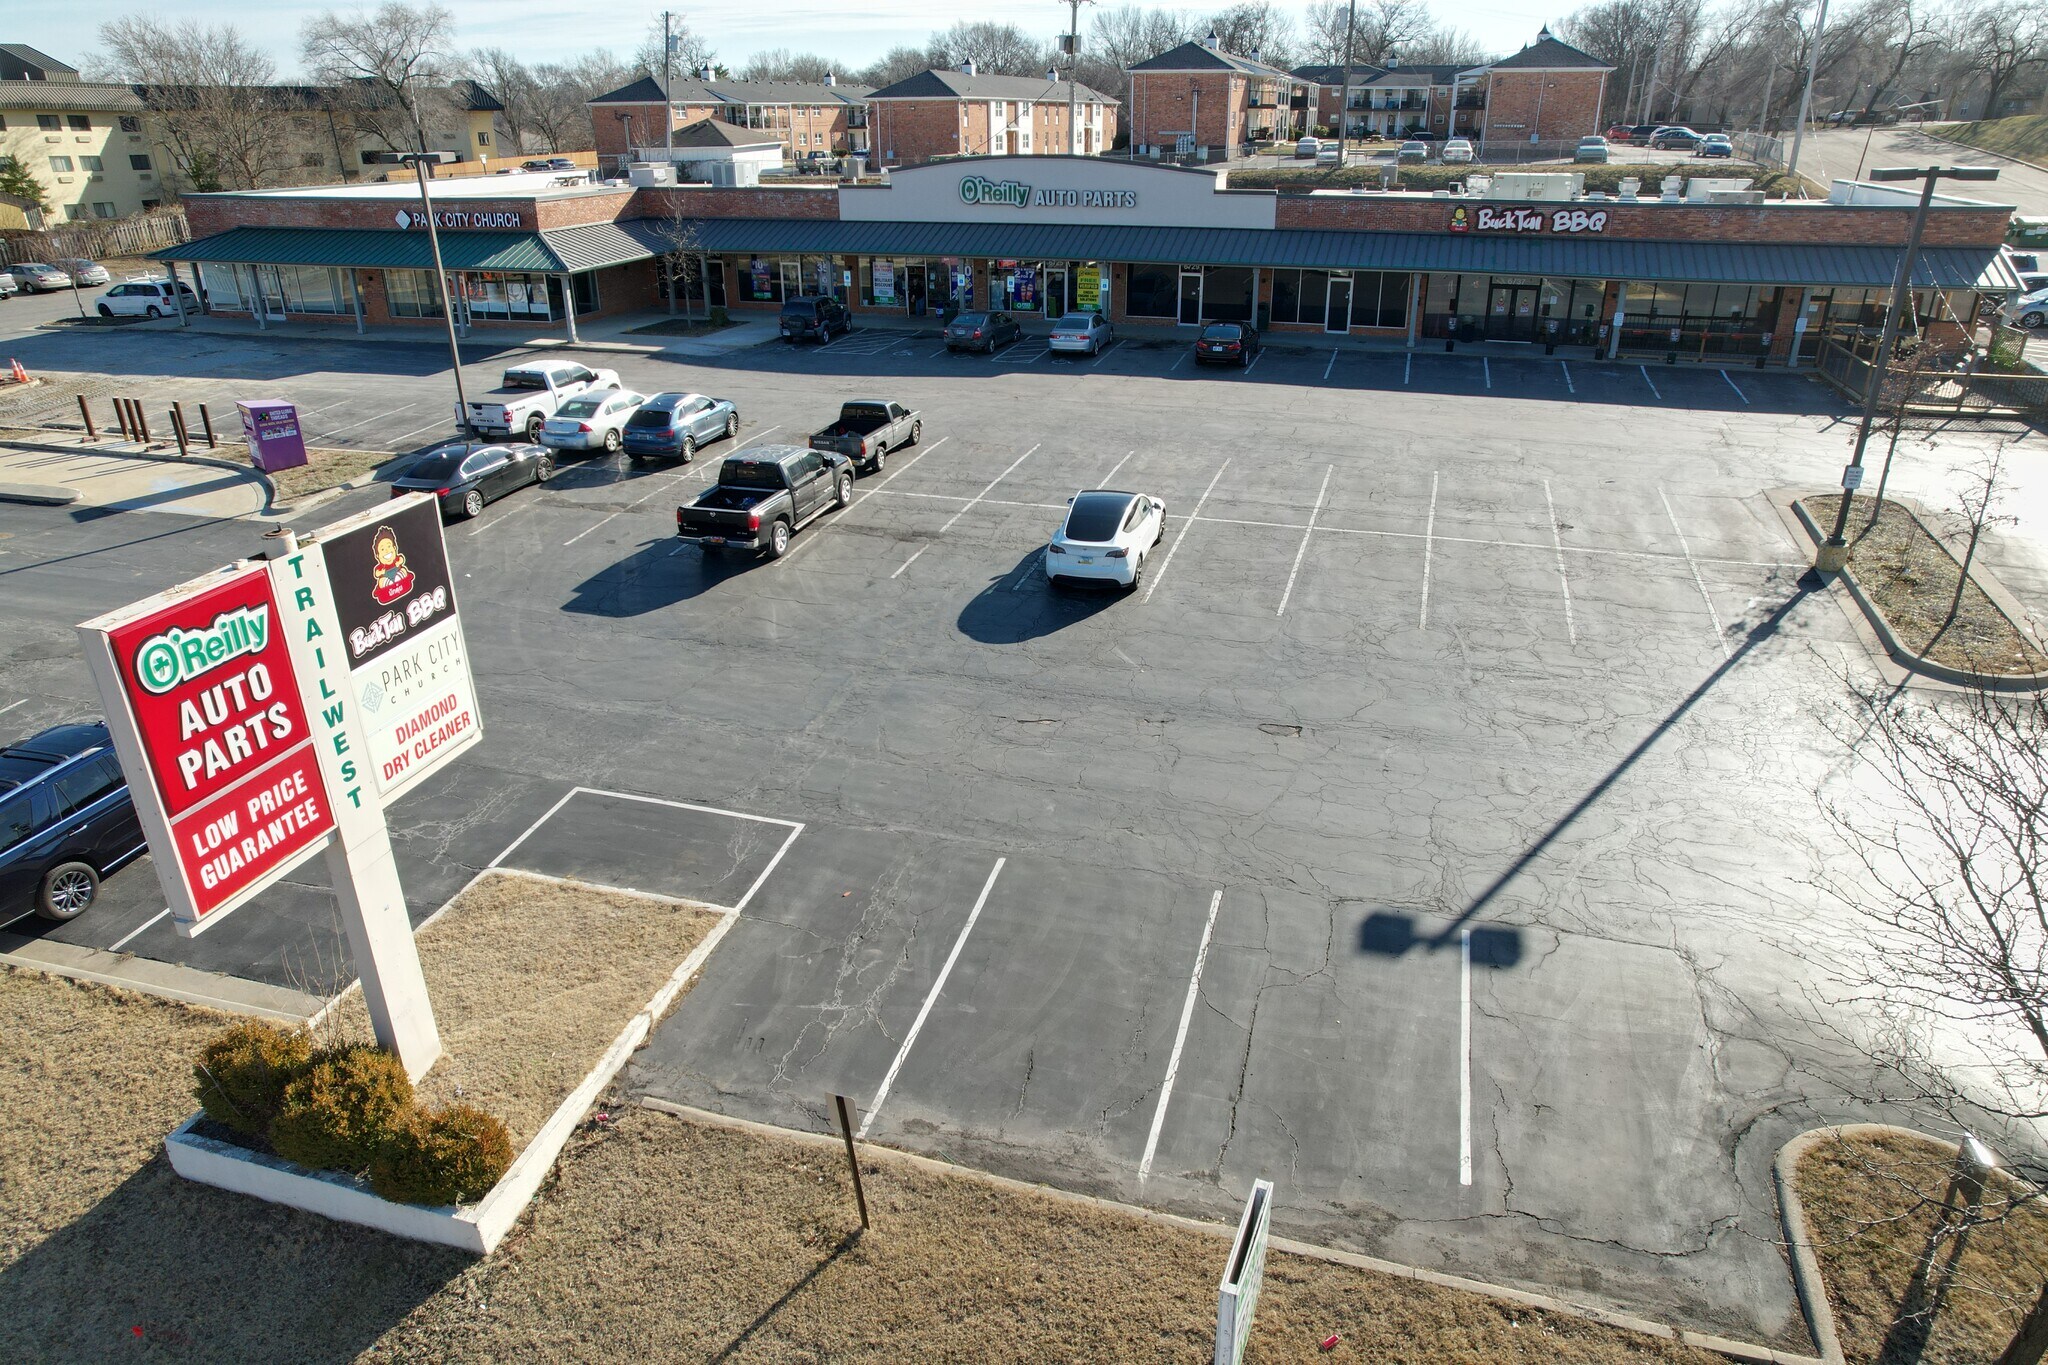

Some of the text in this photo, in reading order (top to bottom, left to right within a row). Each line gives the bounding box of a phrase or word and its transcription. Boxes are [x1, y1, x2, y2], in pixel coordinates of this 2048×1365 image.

[413, 212, 520, 227] PAK CITY CHURCH
[960, 177, 1136, 208] O'Reilly AUTO PARTS
[1552, 210, 1607, 232] BBQ
[406, 586, 446, 625] BBQ
[138, 606, 267, 692] O'Reilly
[381, 631, 460, 692] PARK CITY
[180, 662, 273, 741] AUTO
[390, 658, 461, 705] CHURCH
[177, 701, 292, 790] PARTS
[382, 711, 471, 781] DRY CLEANER
[395, 693, 458, 745] DIAMOND
[192, 769, 308, 858] LOW PRICE
[199, 797, 320, 890] GUARANTEE
